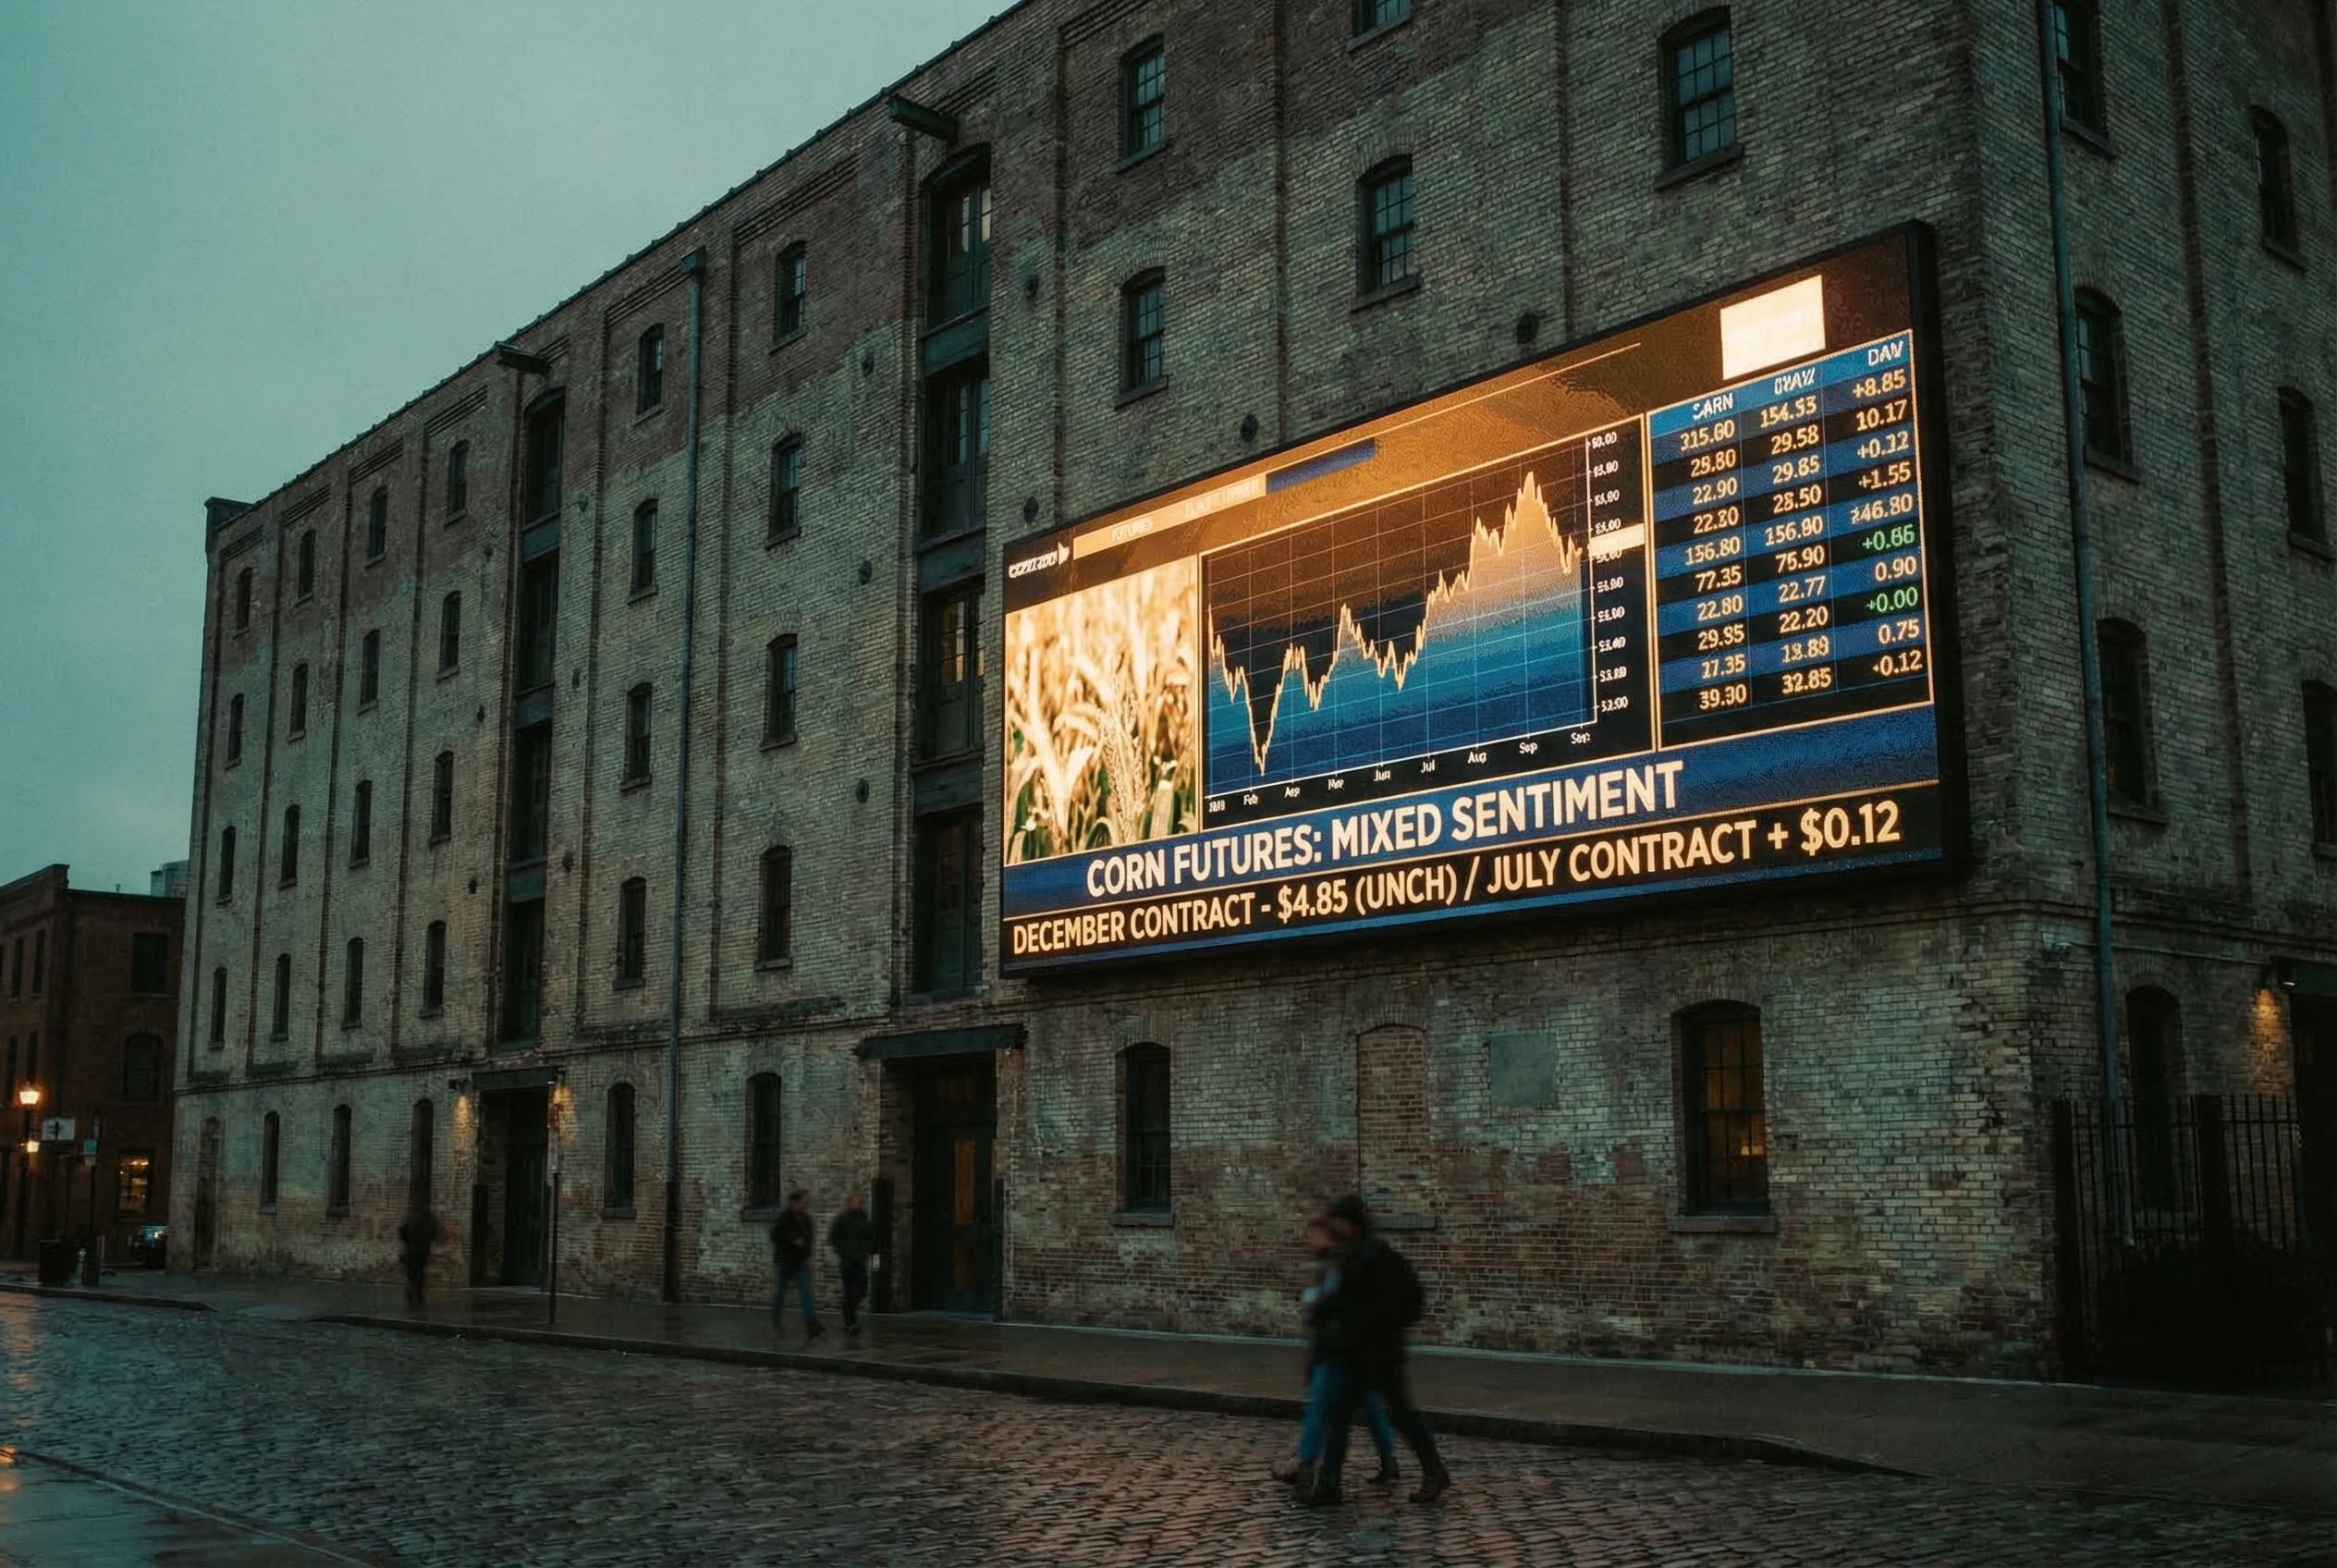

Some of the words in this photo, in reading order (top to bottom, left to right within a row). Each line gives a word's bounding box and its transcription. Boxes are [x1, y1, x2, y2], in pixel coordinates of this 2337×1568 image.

[1853, 368, 1906, 398] +8.85
[1771, 424, 1819, 456] 29.58
[1856, 399, 1907, 432] 10.17
[1693, 477, 1738, 505] 22.90
[1772, 455, 1820, 484] 29.85
[1858, 460, 1911, 489] +1.55
[1695, 565, 1742, 593] 77.35
[1697, 594, 1743, 621] 22.80
[1779, 575, 1826, 604] 22.77
[1875, 556, 1916, 582] 0.90
[1779, 605, 1829, 633] 22.20
[1866, 586, 1918, 613] +0.00
[1878, 619, 1920, 644] 0.75
[1699, 683, 1747, 710] 39.30
[1781, 668, 1831, 694] 32.85
[1420, 759, 1436, 774] Jul
[1086, 848, 1166, 898] CORN
[1174, 824, 1322, 885] FUTURES:
[1332, 803, 1442, 860] MIXED
[1450, 760, 1684, 842] SENTIMENT
[1013, 910, 1125, 955] DECEMBER
[1130, 891, 1255, 940] CONTRACT
[1278, 878, 1349, 925] $4.85
[1354, 864, 1457, 916] (UNCH)
[1463, 855, 1480, 901] /
[1487, 848, 1560, 894] JULY
[1570, 820, 1756, 882] CONTRACT
[1768, 823, 1789, 851] +
[1800, 799, 1901, 856] $0.12
